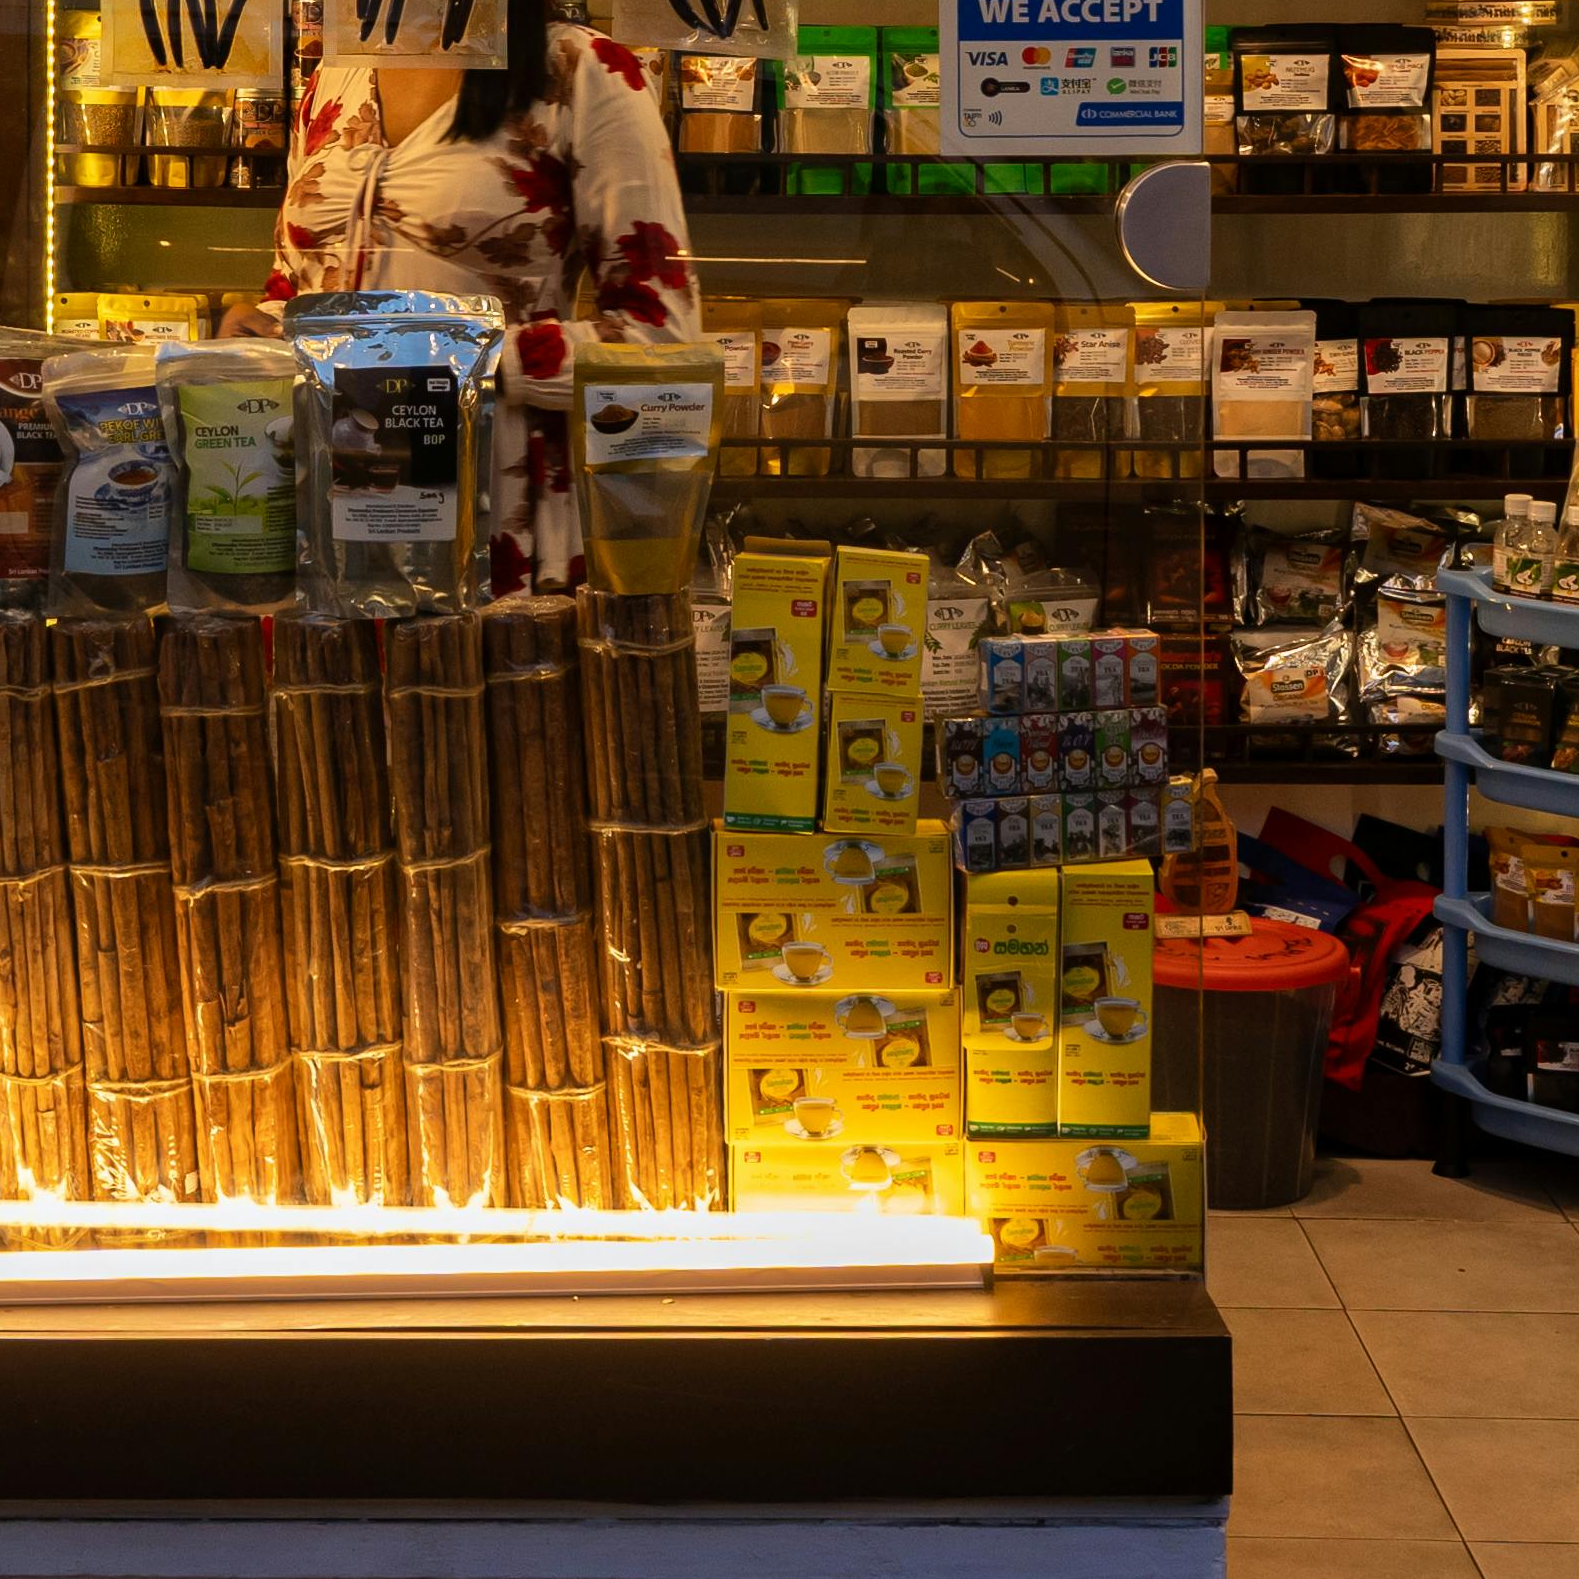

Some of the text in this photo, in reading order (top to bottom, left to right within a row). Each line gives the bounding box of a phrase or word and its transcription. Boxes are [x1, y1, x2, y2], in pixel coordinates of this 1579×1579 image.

[965, 51, 1008, 66] VISA
[1061, 78, 1091, 89] 支付宝
[1099, 110, 1178, 118] COMMERCIAL BANK
[1080, 340, 1121, 348] Star Anise
[20, 373, 42, 390] DP
[385, 378, 408, 394] DP
[126, 402, 147, 416] DP
[246, 399, 270, 414] DP
[391, 404, 437, 417] CEYLON
[641, 402, 705, 414] Curry Powder
[100, 420, 141, 433] PEKOE
[384, 416, 444, 429] BLACK TEA
[16, 431, 44, 440] BLACK
[108, 432, 138, 444] EARL
[195, 425, 239, 438] CEYLON
[194, 436, 257, 449] GREEN TEA
[423, 434, 446, 446] BOP
[929, 622, 952, 630] CURRY
[1305, 668, 1319, 677] OP
